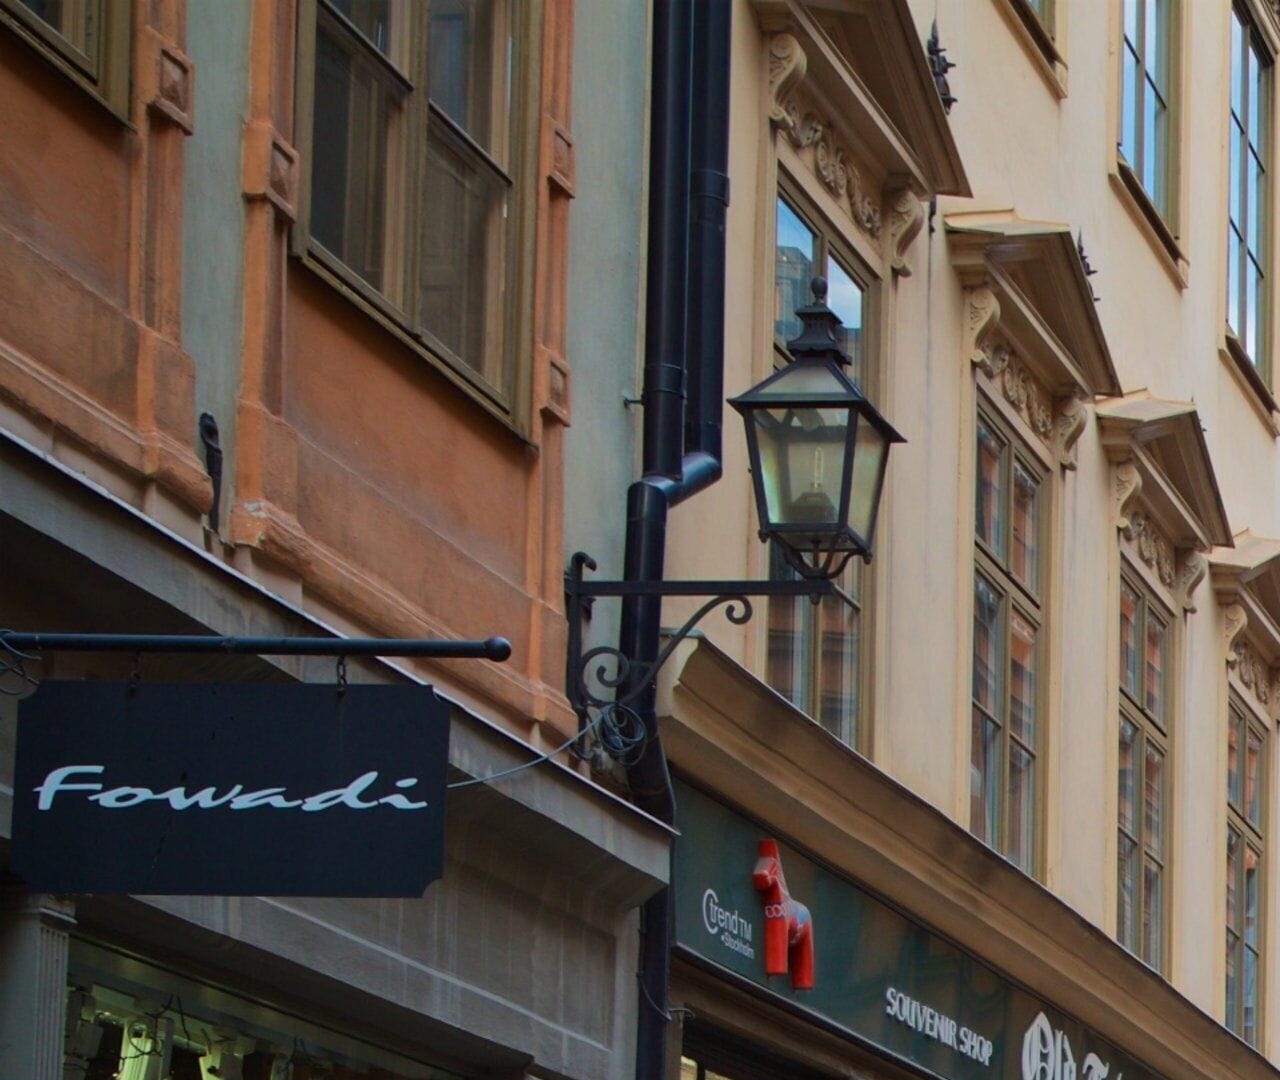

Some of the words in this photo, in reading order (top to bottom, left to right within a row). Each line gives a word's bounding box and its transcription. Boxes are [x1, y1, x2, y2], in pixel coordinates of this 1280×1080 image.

[34, 764, 428, 812] Fowadi
[885, 986, 958, 1050] SOUVENIR
[959, 1026, 993, 1067] SHOP
